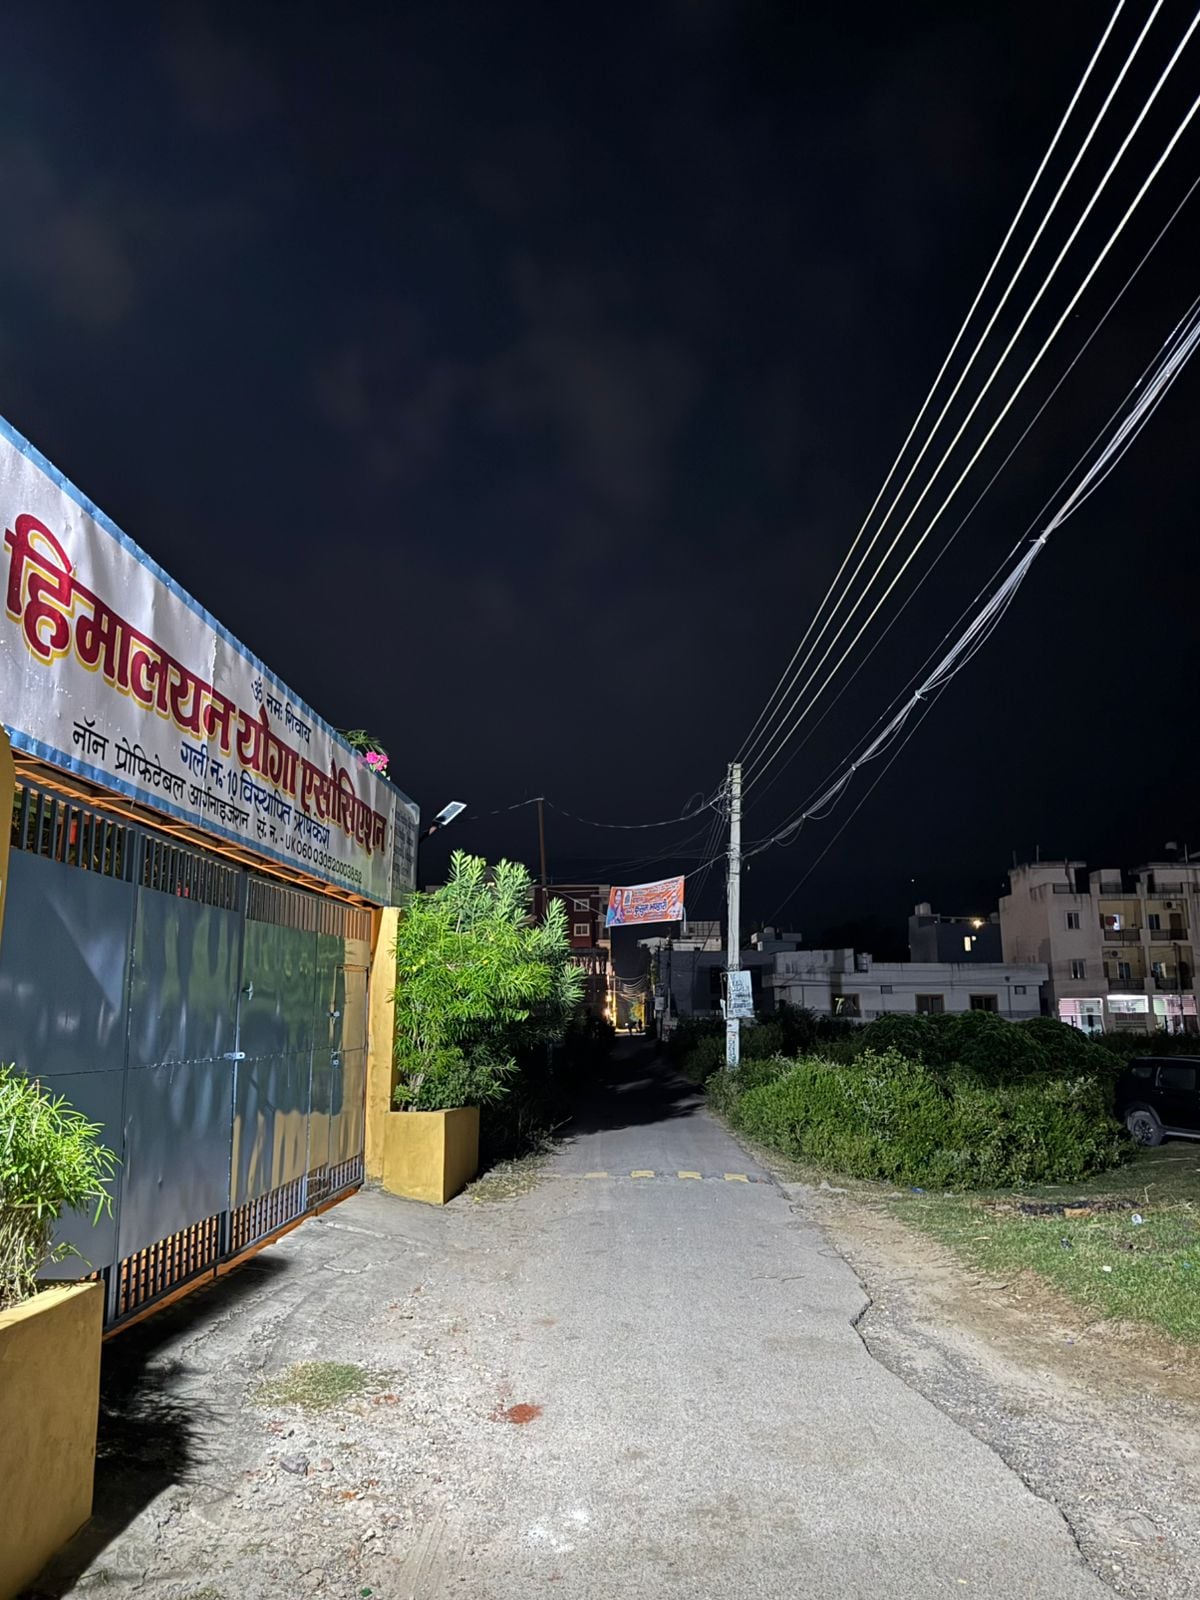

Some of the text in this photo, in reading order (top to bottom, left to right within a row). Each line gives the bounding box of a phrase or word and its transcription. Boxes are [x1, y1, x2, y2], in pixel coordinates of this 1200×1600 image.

[4, 513, 236, 756] हिमालयन
[236, 703, 300, 798] योगा
[300, 757, 387, 857] एसोसिएशन
[266, 692, 283, 721] नमः
[285, 702, 312, 745] शिवाय
[73, 716, 110, 761] नॉन
[115, 737, 187, 801] प्रोफिटेबल
[180, 741, 209, 779] गली
